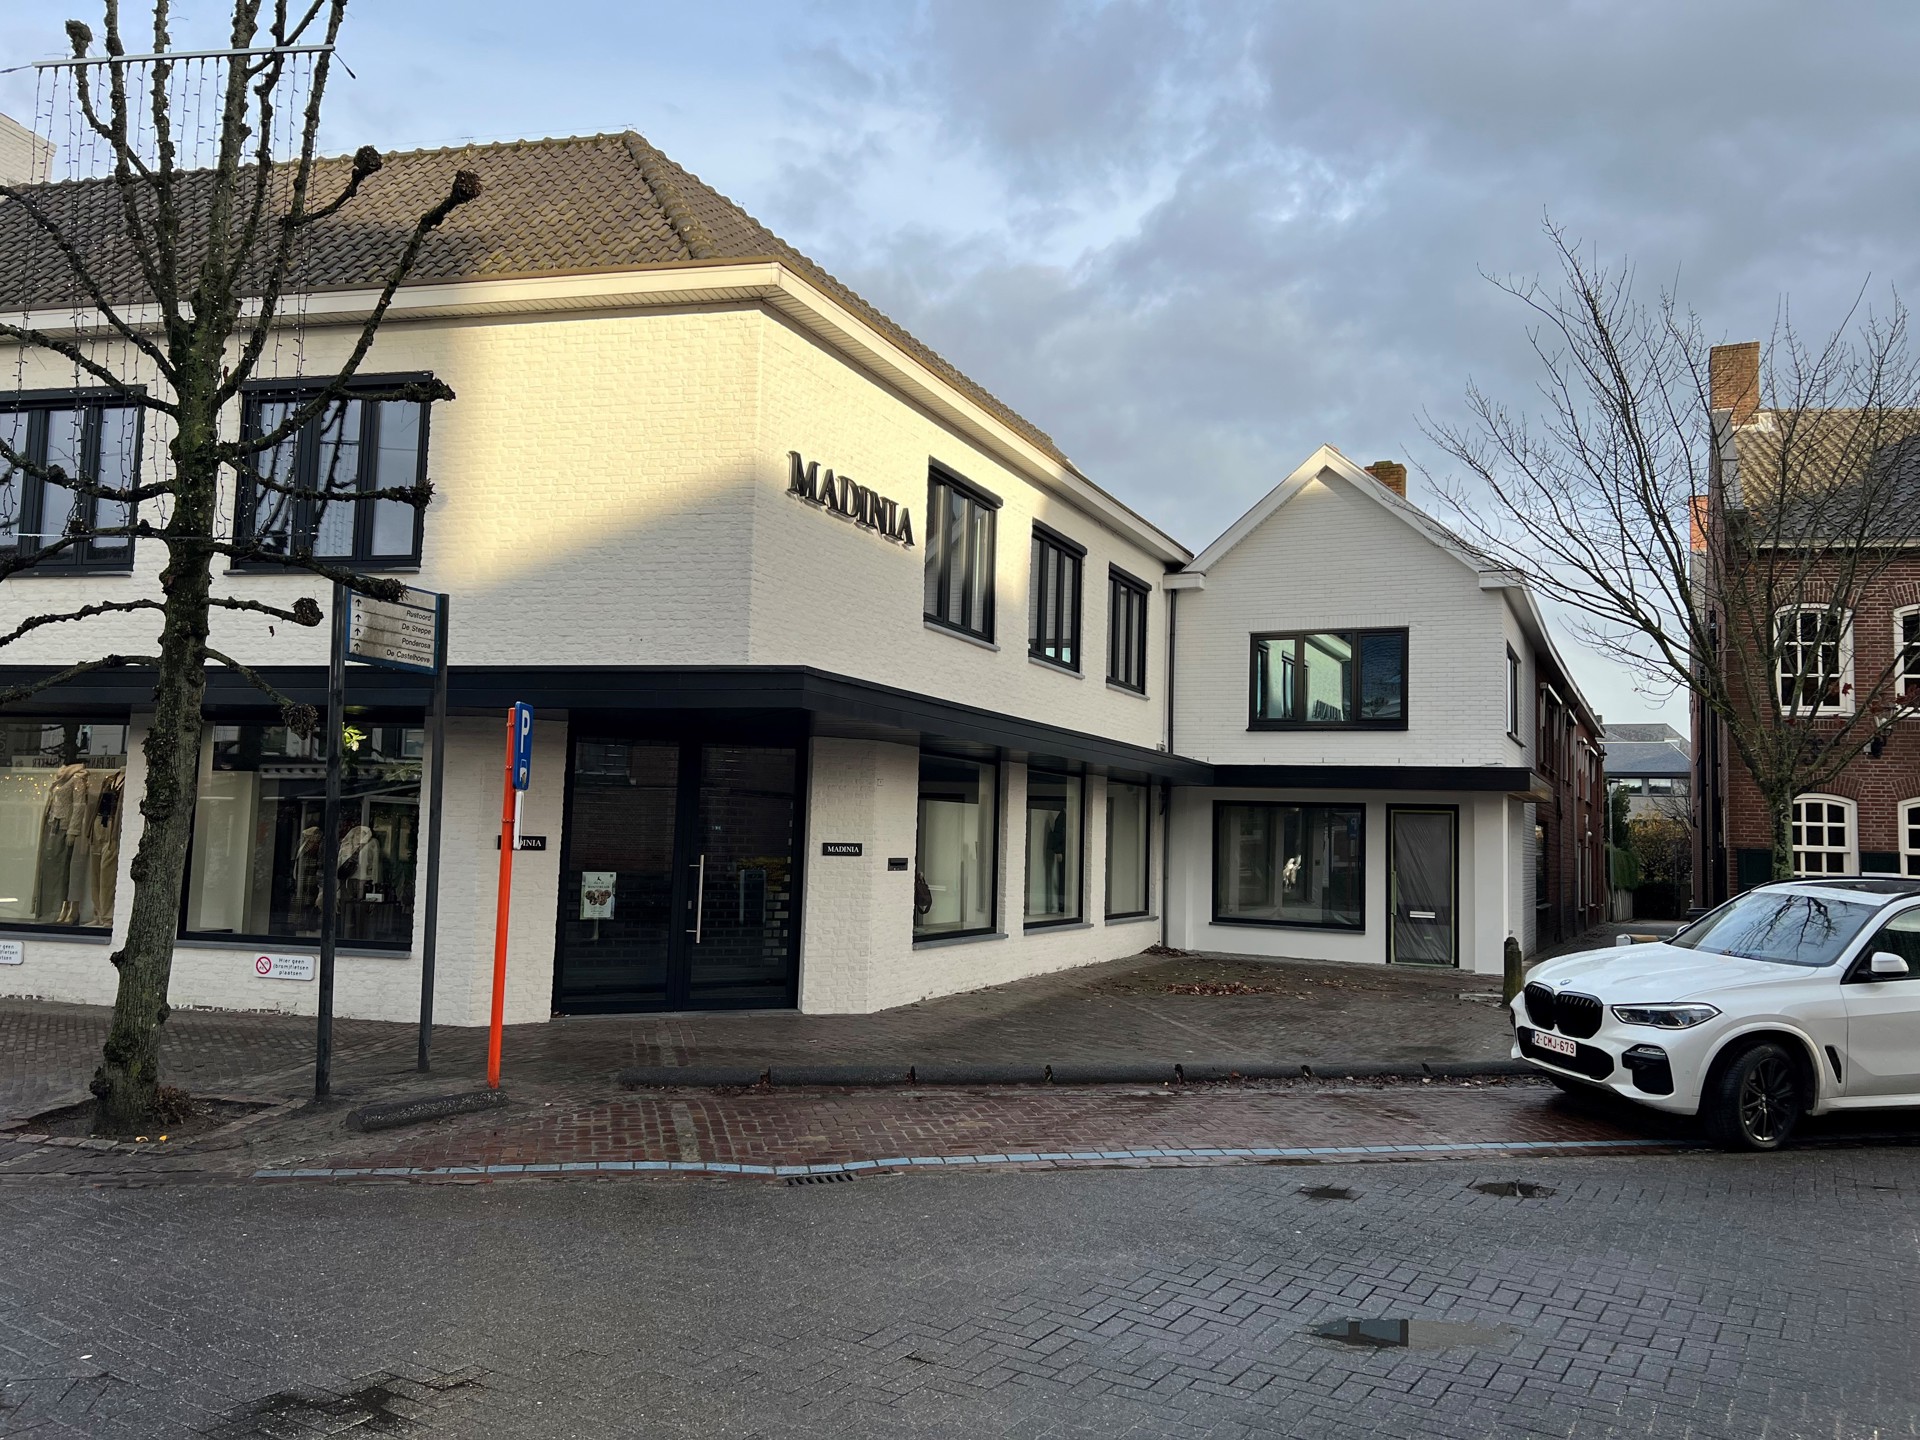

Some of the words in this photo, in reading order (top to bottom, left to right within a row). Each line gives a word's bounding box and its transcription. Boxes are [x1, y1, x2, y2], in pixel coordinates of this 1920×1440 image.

[785, 450, 915, 547] MADINIA
[412, 625, 431, 635] Steppe
[402, 638, 430, 649] Ponderosa
[397, 651, 430, 663] Castelhoeve
[520, 709, 531, 753] P
[1536, 1034, 1574, 1053] 2-CMJ-679
